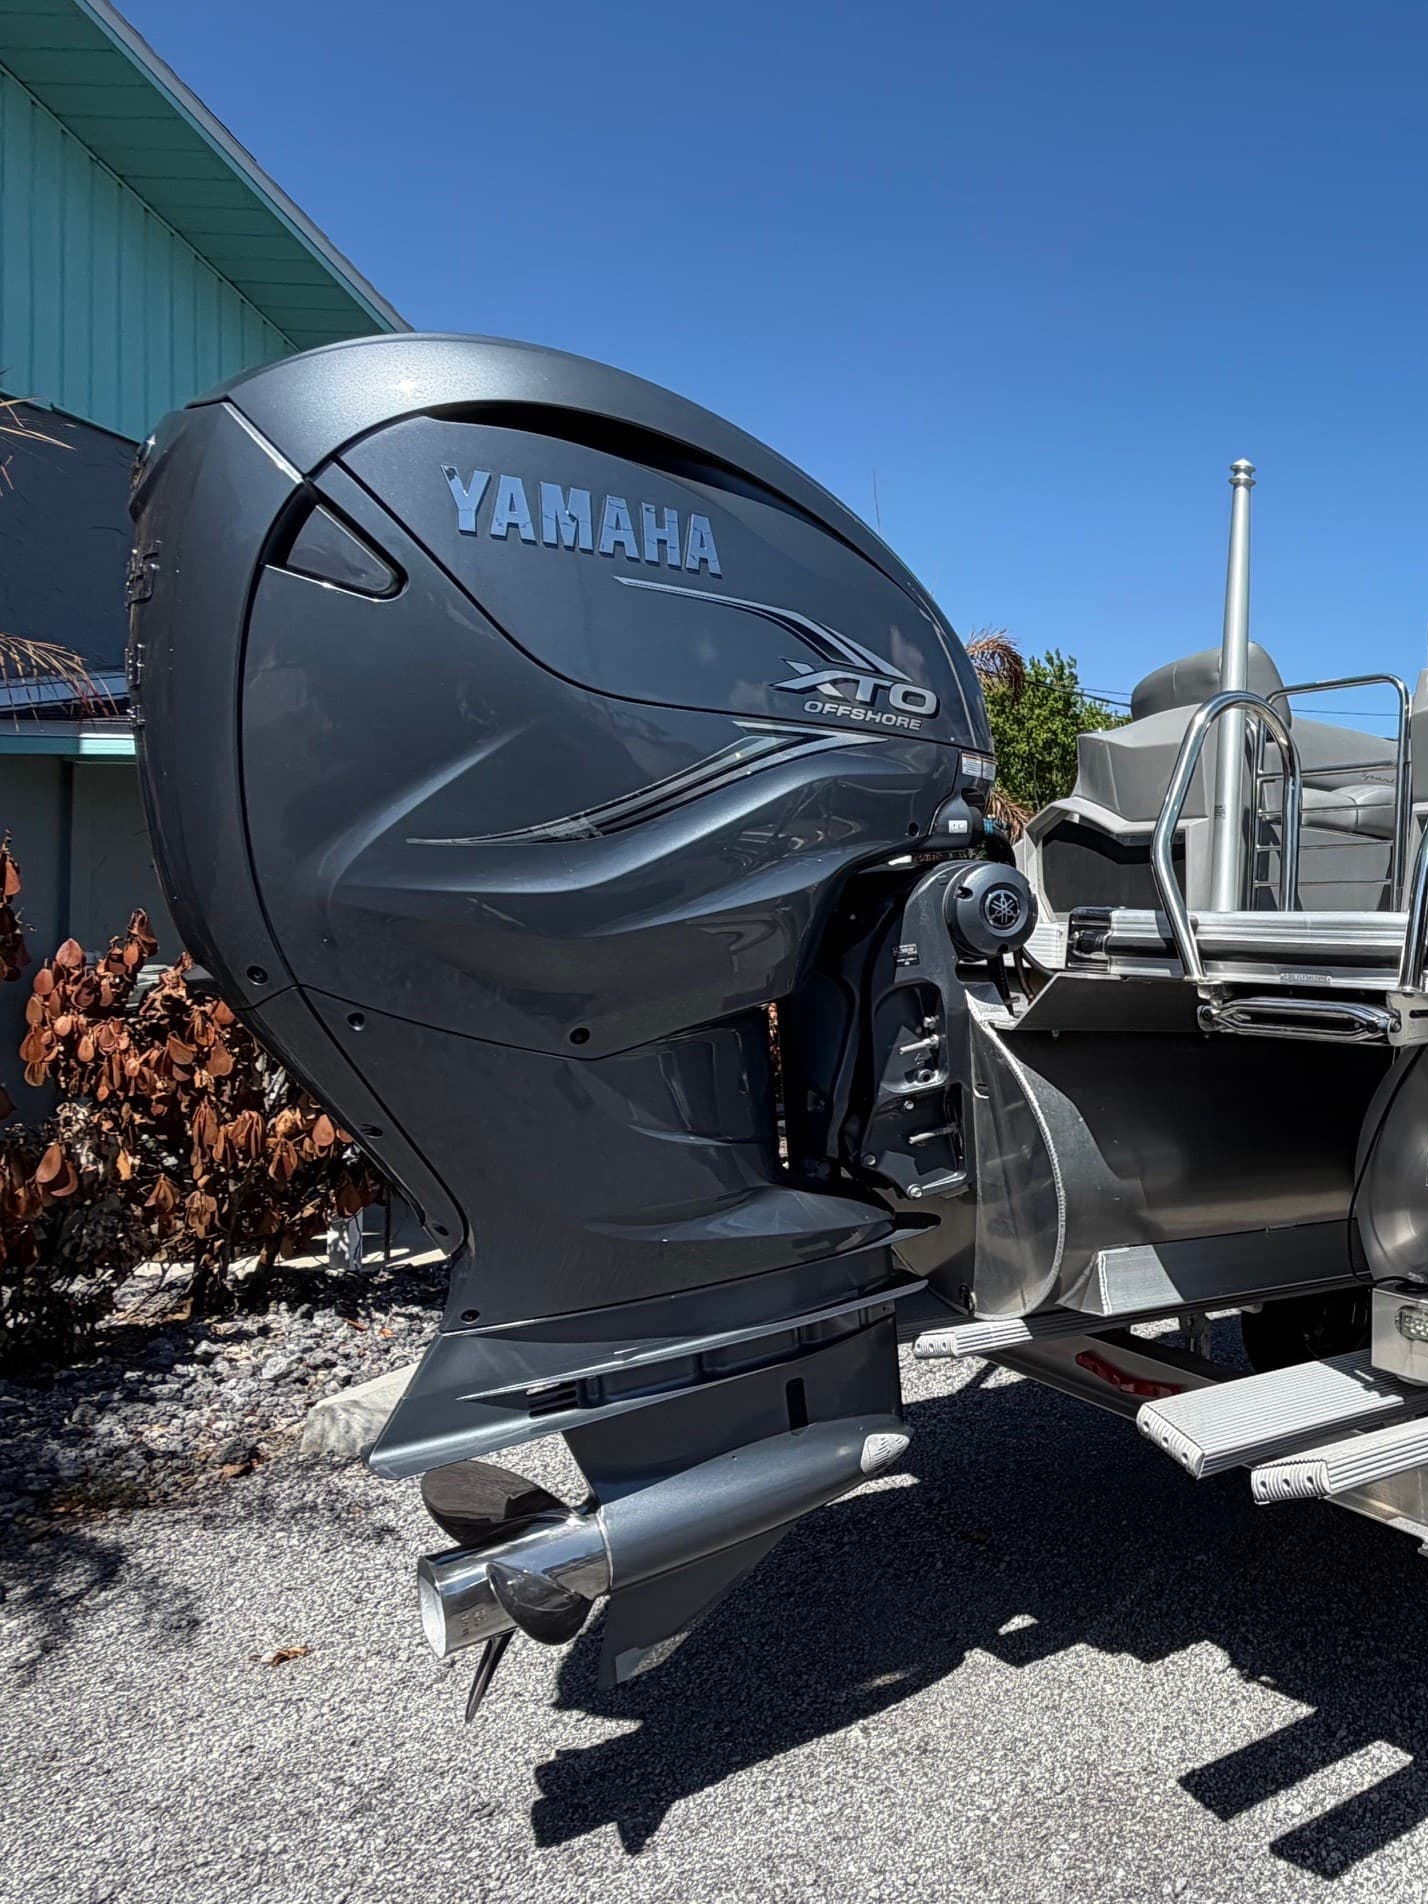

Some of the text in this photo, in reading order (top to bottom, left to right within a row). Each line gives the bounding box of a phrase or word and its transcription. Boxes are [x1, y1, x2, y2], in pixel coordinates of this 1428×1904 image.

[441, 465, 722, 578] YAMAHA
[769, 657, 940, 718] XTO
[803, 700, 922, 731] OFFSHORE
